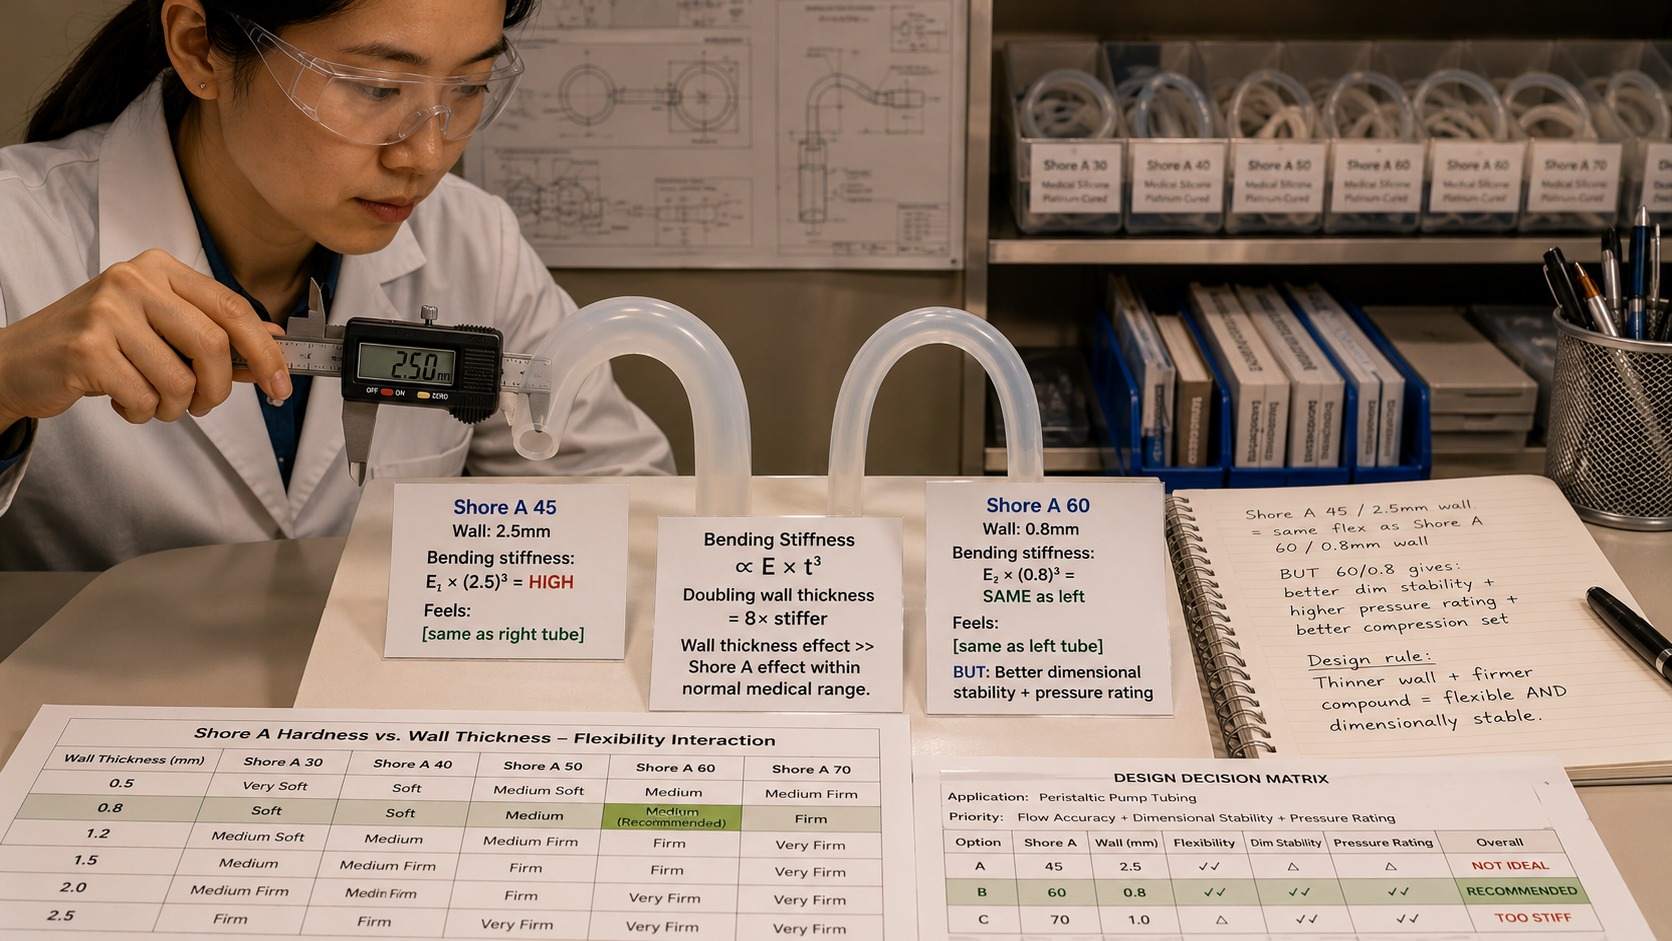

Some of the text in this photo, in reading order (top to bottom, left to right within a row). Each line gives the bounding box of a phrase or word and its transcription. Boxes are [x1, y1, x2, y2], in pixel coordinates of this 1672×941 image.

[1044, 160, 1107, 171] Shore A 30
[1147, 160, 1180, 171] Shore
[1184, 161, 1192, 171] A
[1248, 160, 1281, 171] Shore
[1284, 161, 1292, 171] A
[1348, 160, 1380, 171] Shore
[1384, 161, 1391, 171] A
[1447, 160, 1479, 171] Shore
[1483, 161, 1490, 170] A
[1545, 160, 1607, 171] Shore A 70
[453, 498, 557, 515] Shore A 45
[986, 496, 1090, 513] Shore A 60
[1245, 499, 1471, 520] Shore A 45 2.5mm wall
[452, 523, 551, 538] Wall: 2.5mm
[982, 521, 1080, 536] Wall: 0.8mm
[704, 531, 855, 551] Bending Stiffness
[1275, 535, 1429, 554] 60 0.8mm wall
[427, 549, 575, 568] Bending stiffness:
[762, 557, 776, 576] E
[1280, 562, 1459, 580] BUT 60/0.8 gives:
[529, 574, 574, 590] HIGH
[683, 587, 875, 605] Doubling wall thickness
[983, 589, 1086, 603] SAME as left
[424, 602, 471, 618] Feels:
[774, 610, 828, 626] stiffer
[422, 625, 585, 645] [same as right tube]
[1308, 650, 1432, 670] Design rule:
[953, 664, 1141, 679] BUT: Better dimensional
[682, 680, 870, 700] normal medical range.
[953, 685, 1154, 703] stability pressure rating
[1321, 685, 1567, 714] compound flexible AND
[1329, 708, 1542, 732] dimensionally stable.
[193, 727, 776, 748] Shore A Hardness vs. Wall Thickness Flexibility Interaction
[64, 753, 205, 767] Wall Thickness (mm)
[243, 756, 324, 768] Shore A 30
[772, 764, 852, 775] Shore A 70
[109, 778, 135, 789] 0.5
[1113, 773, 1329, 784] DESIGN DECISION MATRIX
[243, 781, 309, 793] Very Soft
[765, 789, 858, 799] Medium Firm
[947, 792, 1197, 805] Application: Peristaltic Pump Tubing
[97, 802, 124, 813] 0.8
[949, 811, 1396, 825] Priority: Flow Accuracy Dimensional Stability Pressure Rating
[87, 828, 111, 839] 1.2
[955, 837, 1002, 849] Option
[1024, 838, 1078, 848] Shore A
[1095, 838, 1159, 849] Wall (mm)
[1173, 838, 1236, 849] Flexibility
[1250, 838, 1322, 849] Dim Stability
[1333, 838, 1434, 849] Pressure Rating
[1476, 837, 1524, 847] Overall
[975, 861, 986, 871] A
[1044, 862, 1063, 872] 45
[1119, 862, 1142, 872] 2.5
[1471, 861, 1550, 871] NOT IDEAL
[59, 881, 87, 893] 2.0
[977, 887, 987, 897] B
[1047, 887, 1067, 898] 60
[1123, 887, 1147, 898] 0.8
[1466, 886, 1578, 897] RECOMMENDED
[389, 888, 417, 899] Firm
[46, 909, 76, 922] 2.5
[978, 914, 989, 925] C
[1050, 914, 1070, 925] 70
[1128, 914, 1150, 925] 1.0
[1494, 912, 1572, 923] TOO STIFF
[626, 921, 699, 935] Very Firm
